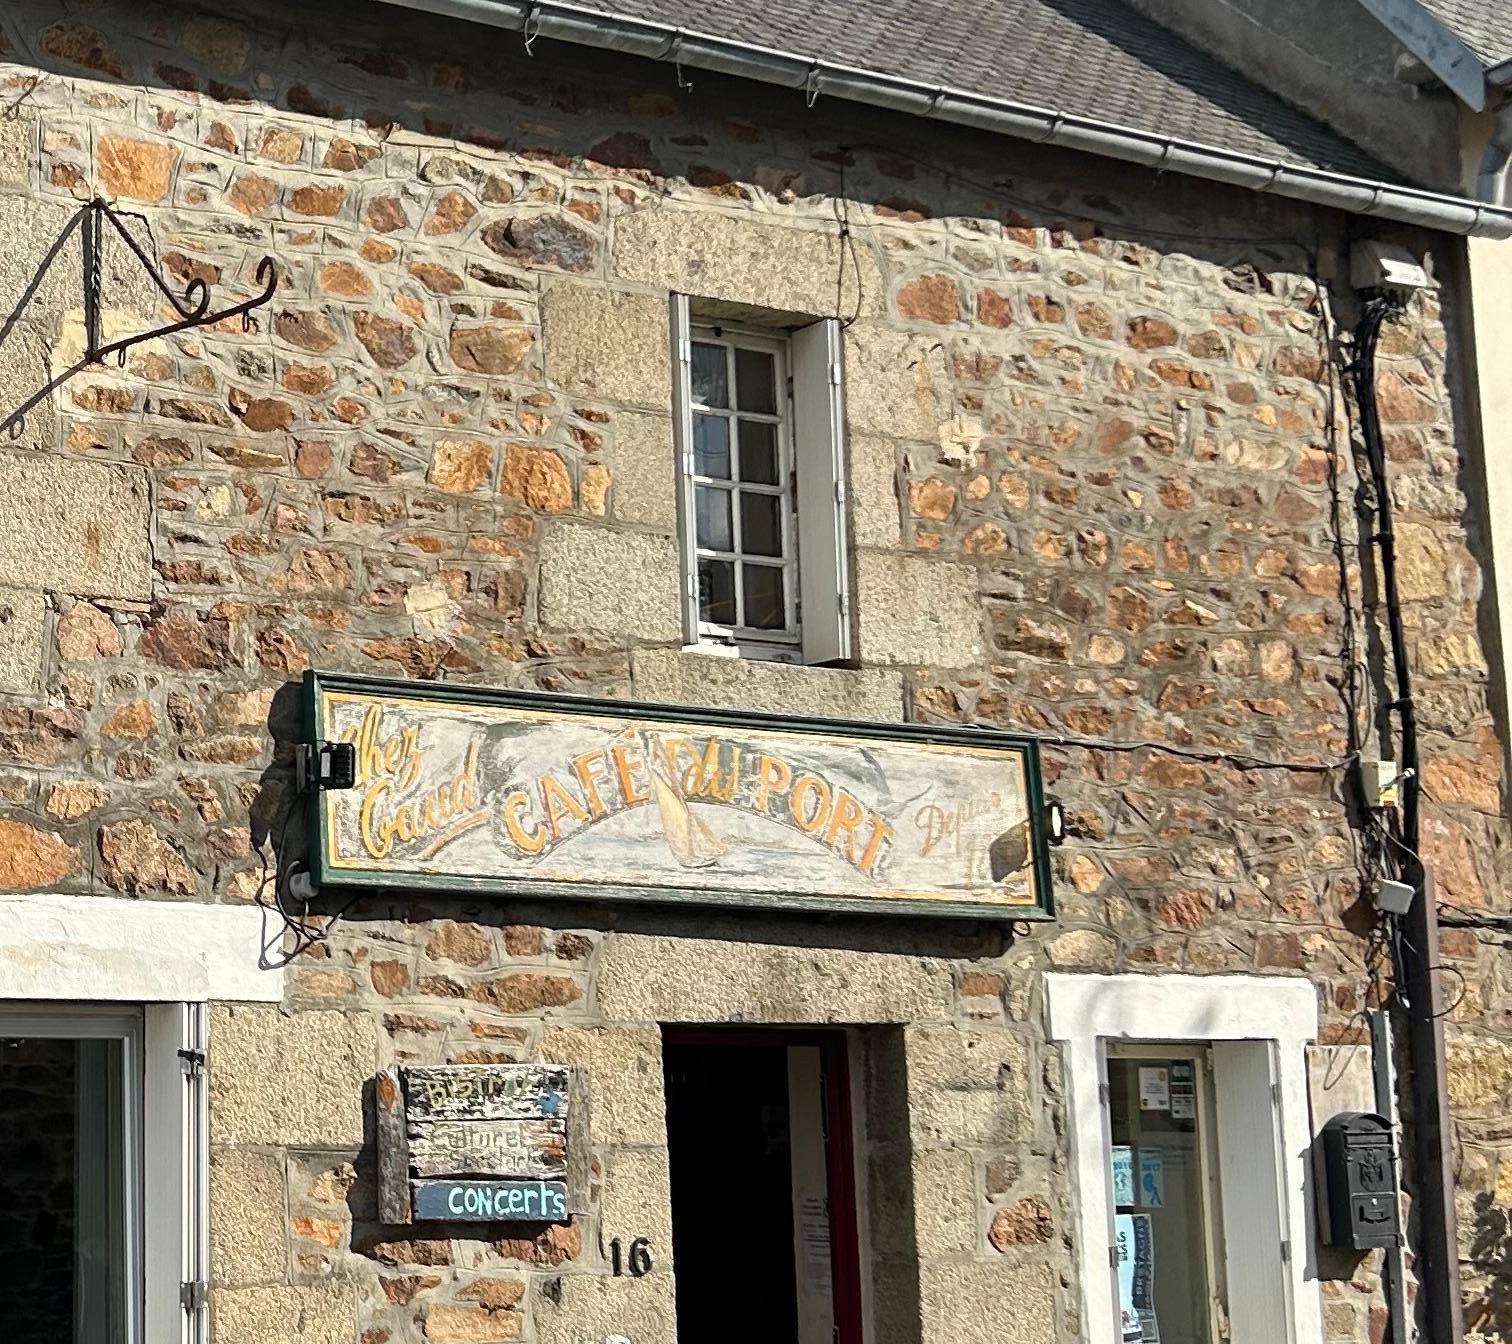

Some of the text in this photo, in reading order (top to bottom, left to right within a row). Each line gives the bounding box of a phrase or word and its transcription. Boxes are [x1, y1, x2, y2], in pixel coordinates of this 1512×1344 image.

[505, 722, 651, 856] CAFÉ
[756, 752, 896, 873] PORT
[609, 1237, 653, 1277] 16
